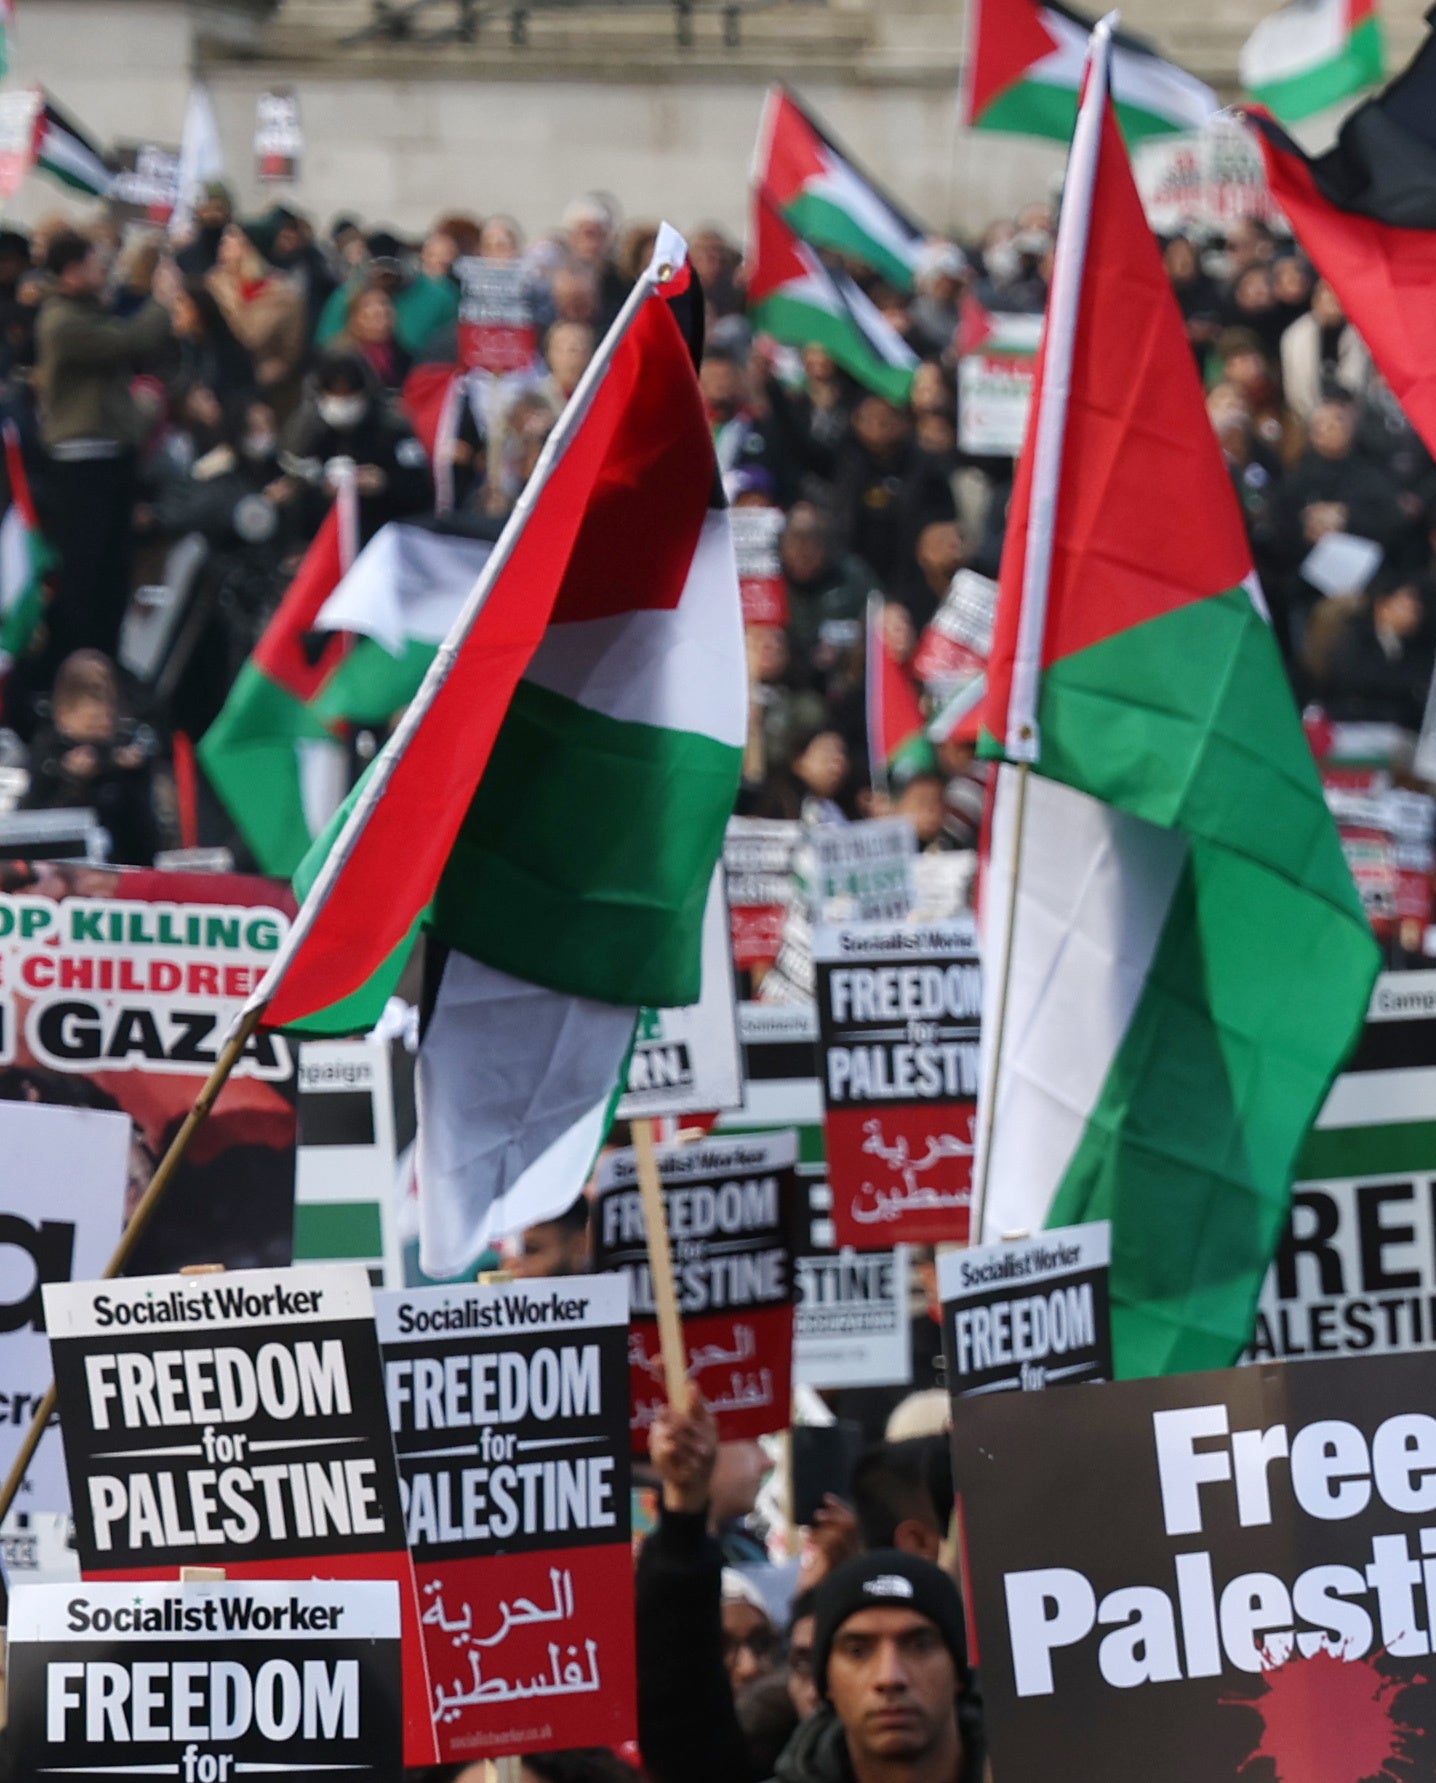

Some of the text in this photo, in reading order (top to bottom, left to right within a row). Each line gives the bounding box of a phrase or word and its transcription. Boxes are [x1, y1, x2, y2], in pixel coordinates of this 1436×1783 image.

[72, 909, 280, 951] KILLING
[955, 1284, 1096, 1376] FREEDOM
[84, 1339, 352, 1432] FREEDOM
[386, 1344, 602, 1433] FREEDOM
[202, 1425, 247, 1464] for
[480, 1426, 519, 1464] for
[87, 1459, 387, 1551] PALESTINE
[46, 1659, 360, 1743] FREEDOM
